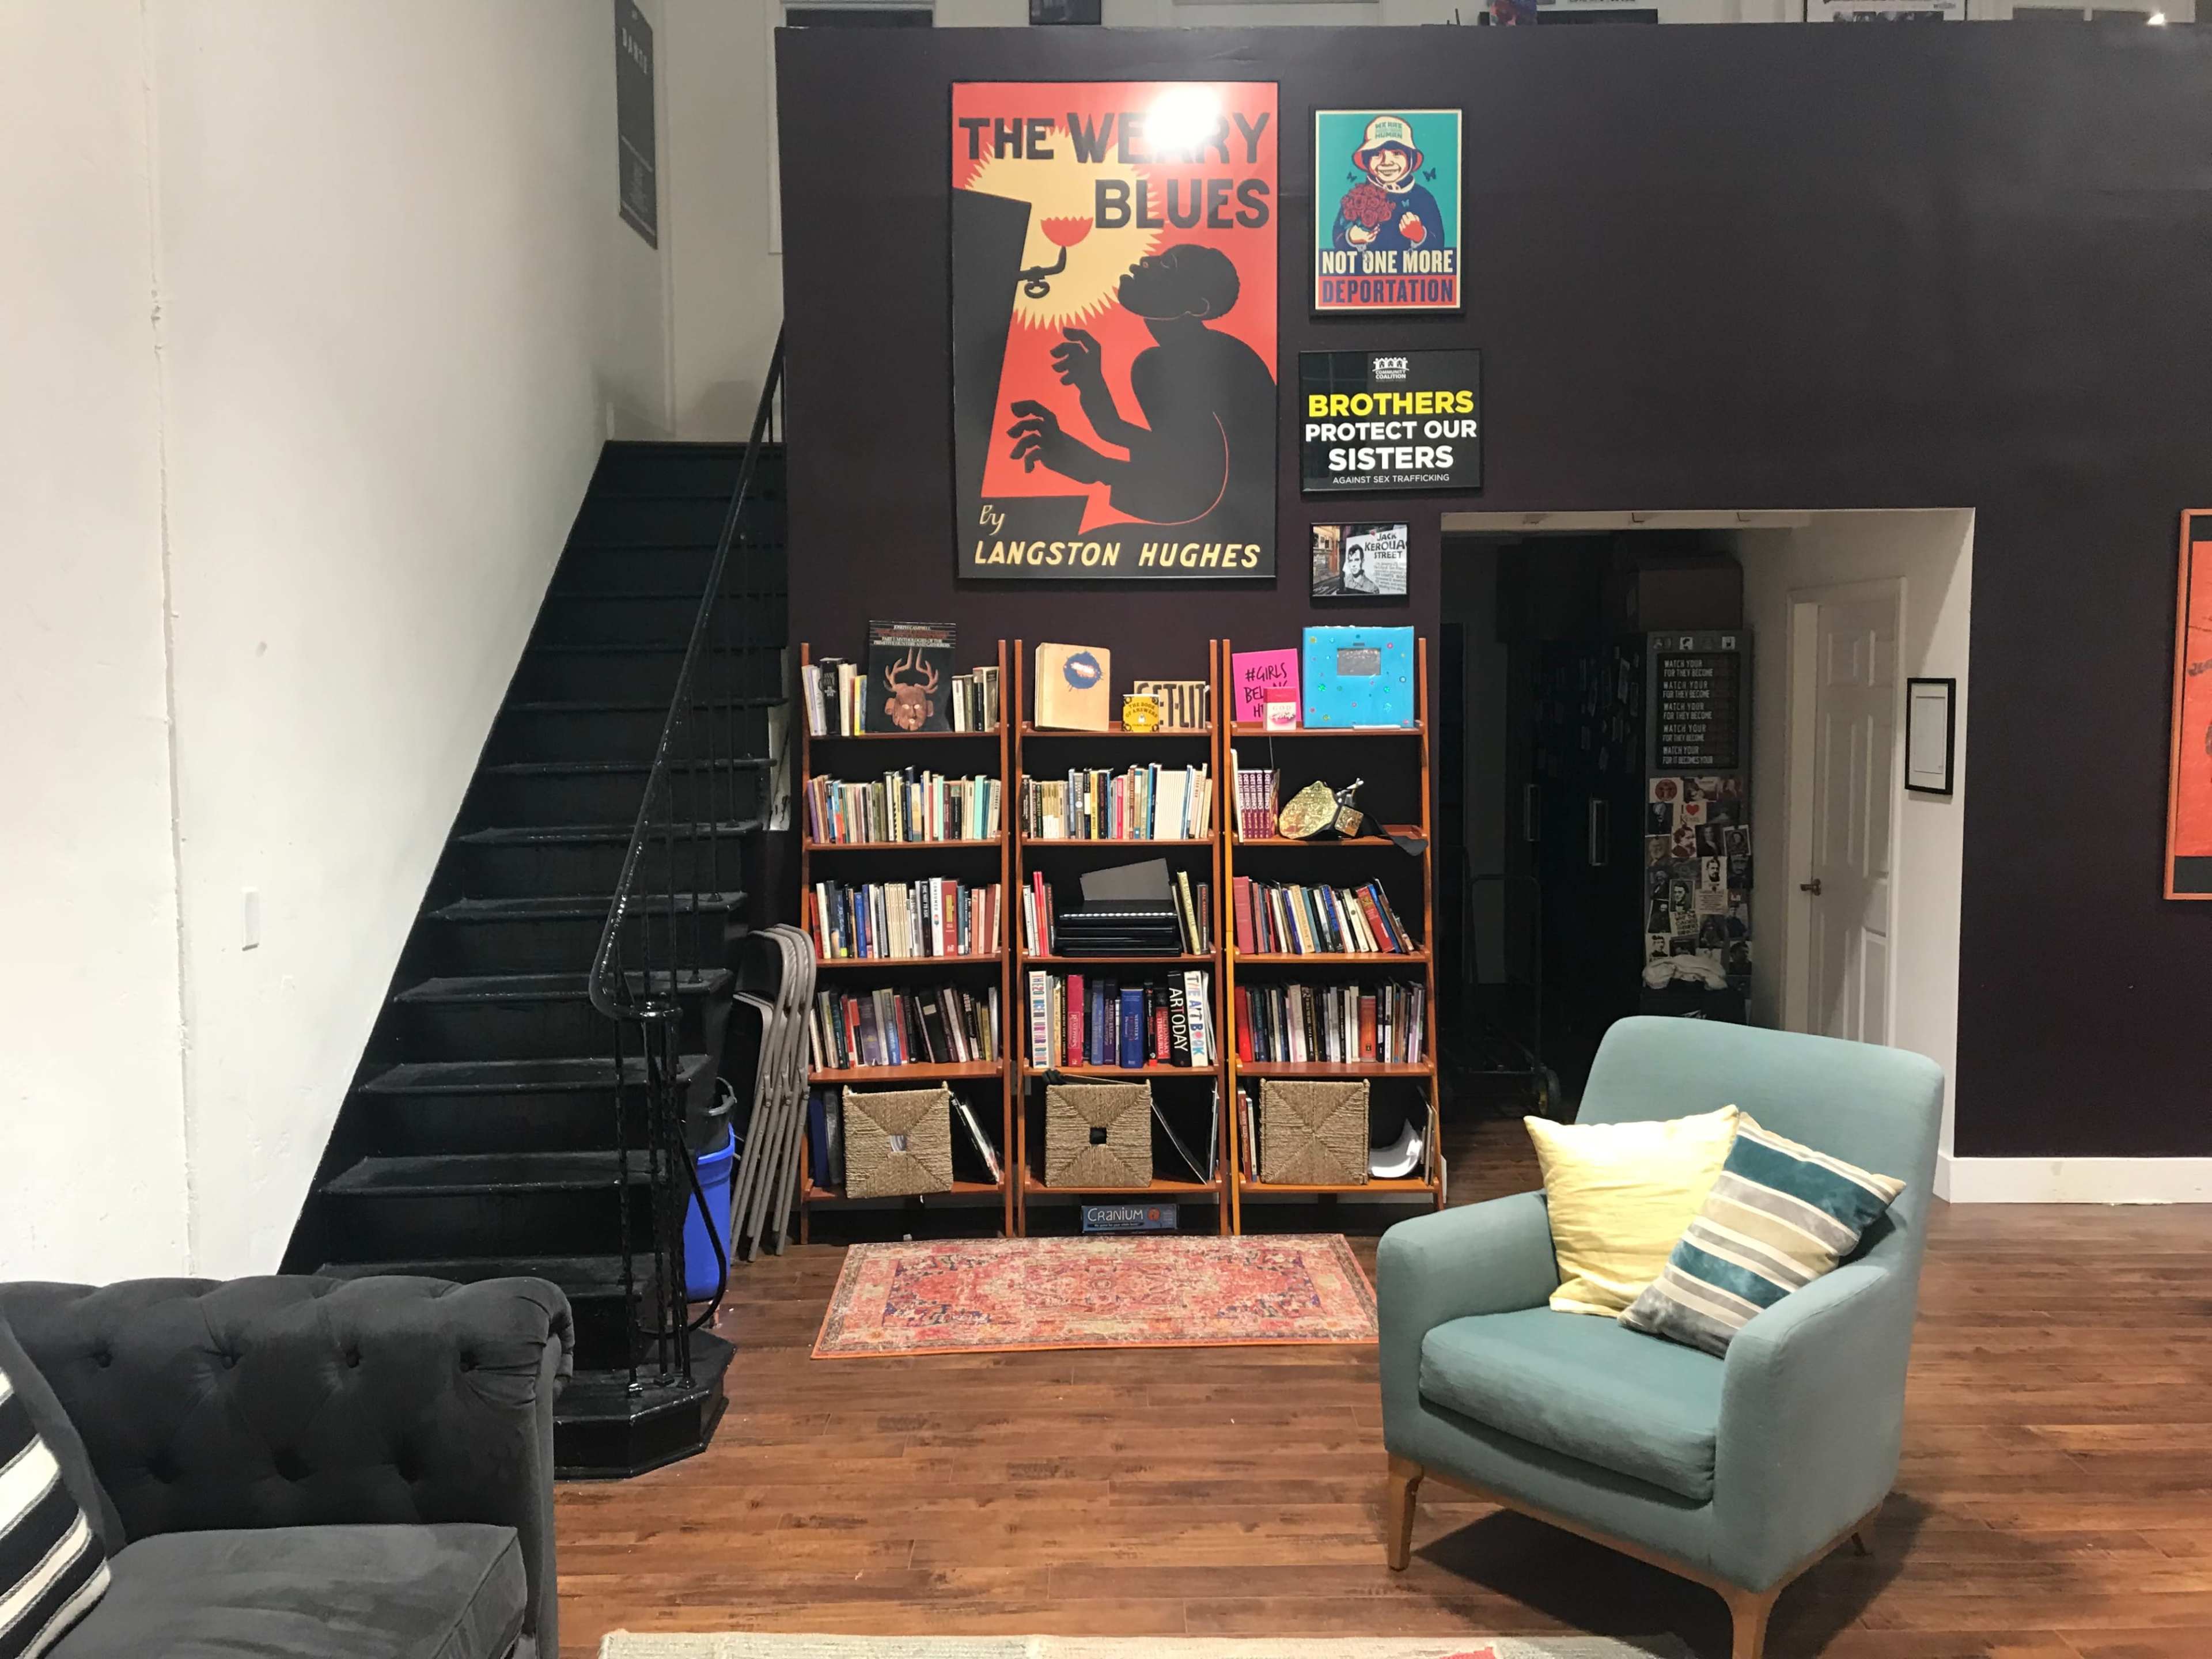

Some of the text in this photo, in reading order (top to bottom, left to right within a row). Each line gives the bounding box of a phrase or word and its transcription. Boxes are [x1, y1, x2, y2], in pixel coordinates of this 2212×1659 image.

[959, 117, 1055, 160] THE
[1095, 179, 1270, 229] BLUES
[1322, 250, 1453, 274] NOT ONE MORE
[1323, 279, 1453, 302] DEPORTATION
[1308, 390, 1474, 417] BROTHERS
[1305, 420, 1477, 442] PROTECT OUR
[1328, 445, 1454, 471] SISTERS
[1332, 476, 1371, 484] AGAINST
[1392, 474, 1449, 482] TRAFFICKING
[1377, 533, 1397, 541] JACK
[1365, 540, 1406, 551] KEROUA
[975, 541, 1260, 568] LANGSTON HUGHES
[1374, 551, 1403, 559] STREET
[1245, 662, 1287, 682] #GIRLS
[1664, 669, 1675, 677] FOR
[1677, 669, 1691, 677] THEY
[1664, 681, 1708, 689] WATCH YOUR
[1663, 690, 1673, 698] FOR
[1689, 690, 1710, 698] BECOME
[1664, 711, 1712, 719] FOR THEY BECOME
[1689, 724, 1707, 732] YOUR
[1663, 746, 1699, 754] WATCH YOUR
[1662, 756, 1672, 764] FOR
[1699, 756, 1713, 764] YOUR
[1169, 987, 1188, 1051] ARTODAY
[1187, 976, 1205, 1055] THE ART BOOK
